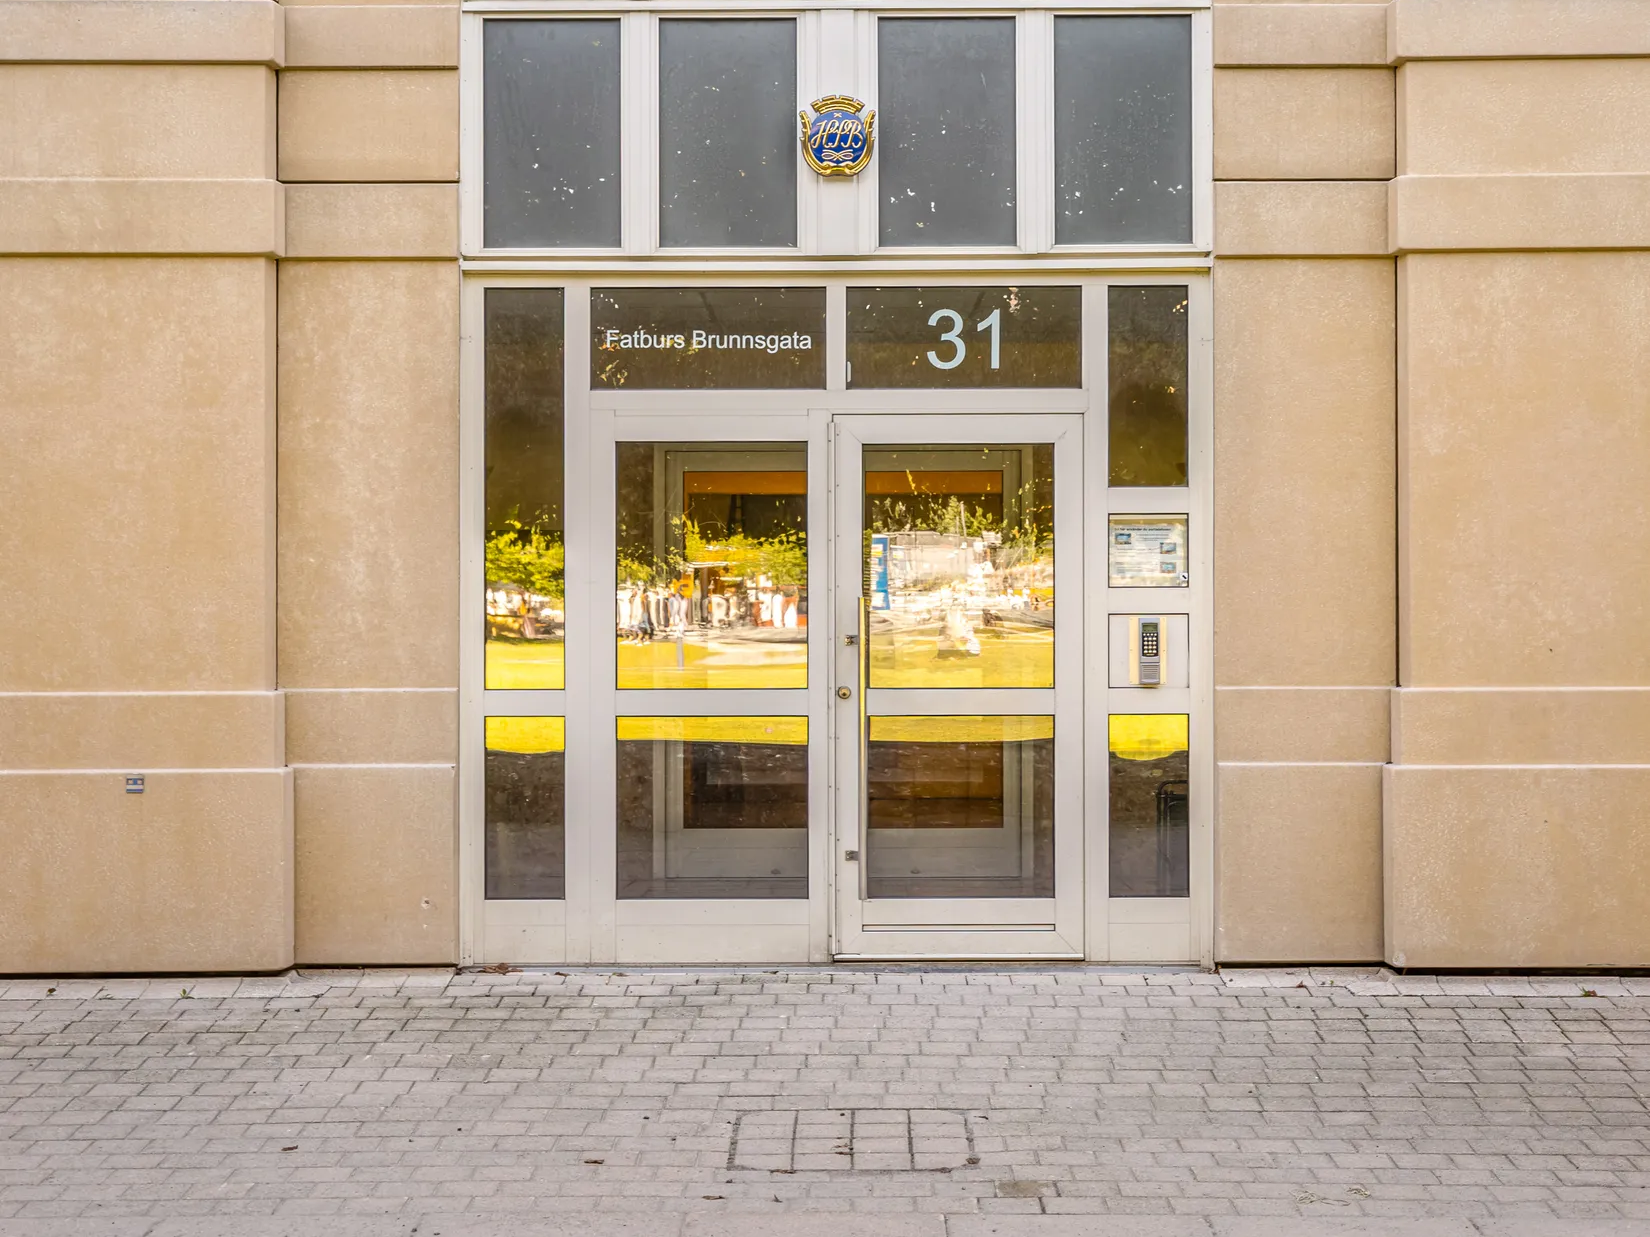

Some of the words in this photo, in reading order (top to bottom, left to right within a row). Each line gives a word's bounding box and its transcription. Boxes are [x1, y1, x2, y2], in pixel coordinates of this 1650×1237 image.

[606, 329, 685, 349] Fatburs
[692, 329, 812, 354] Brunnsgata
[926, 308, 1001, 370] 31
